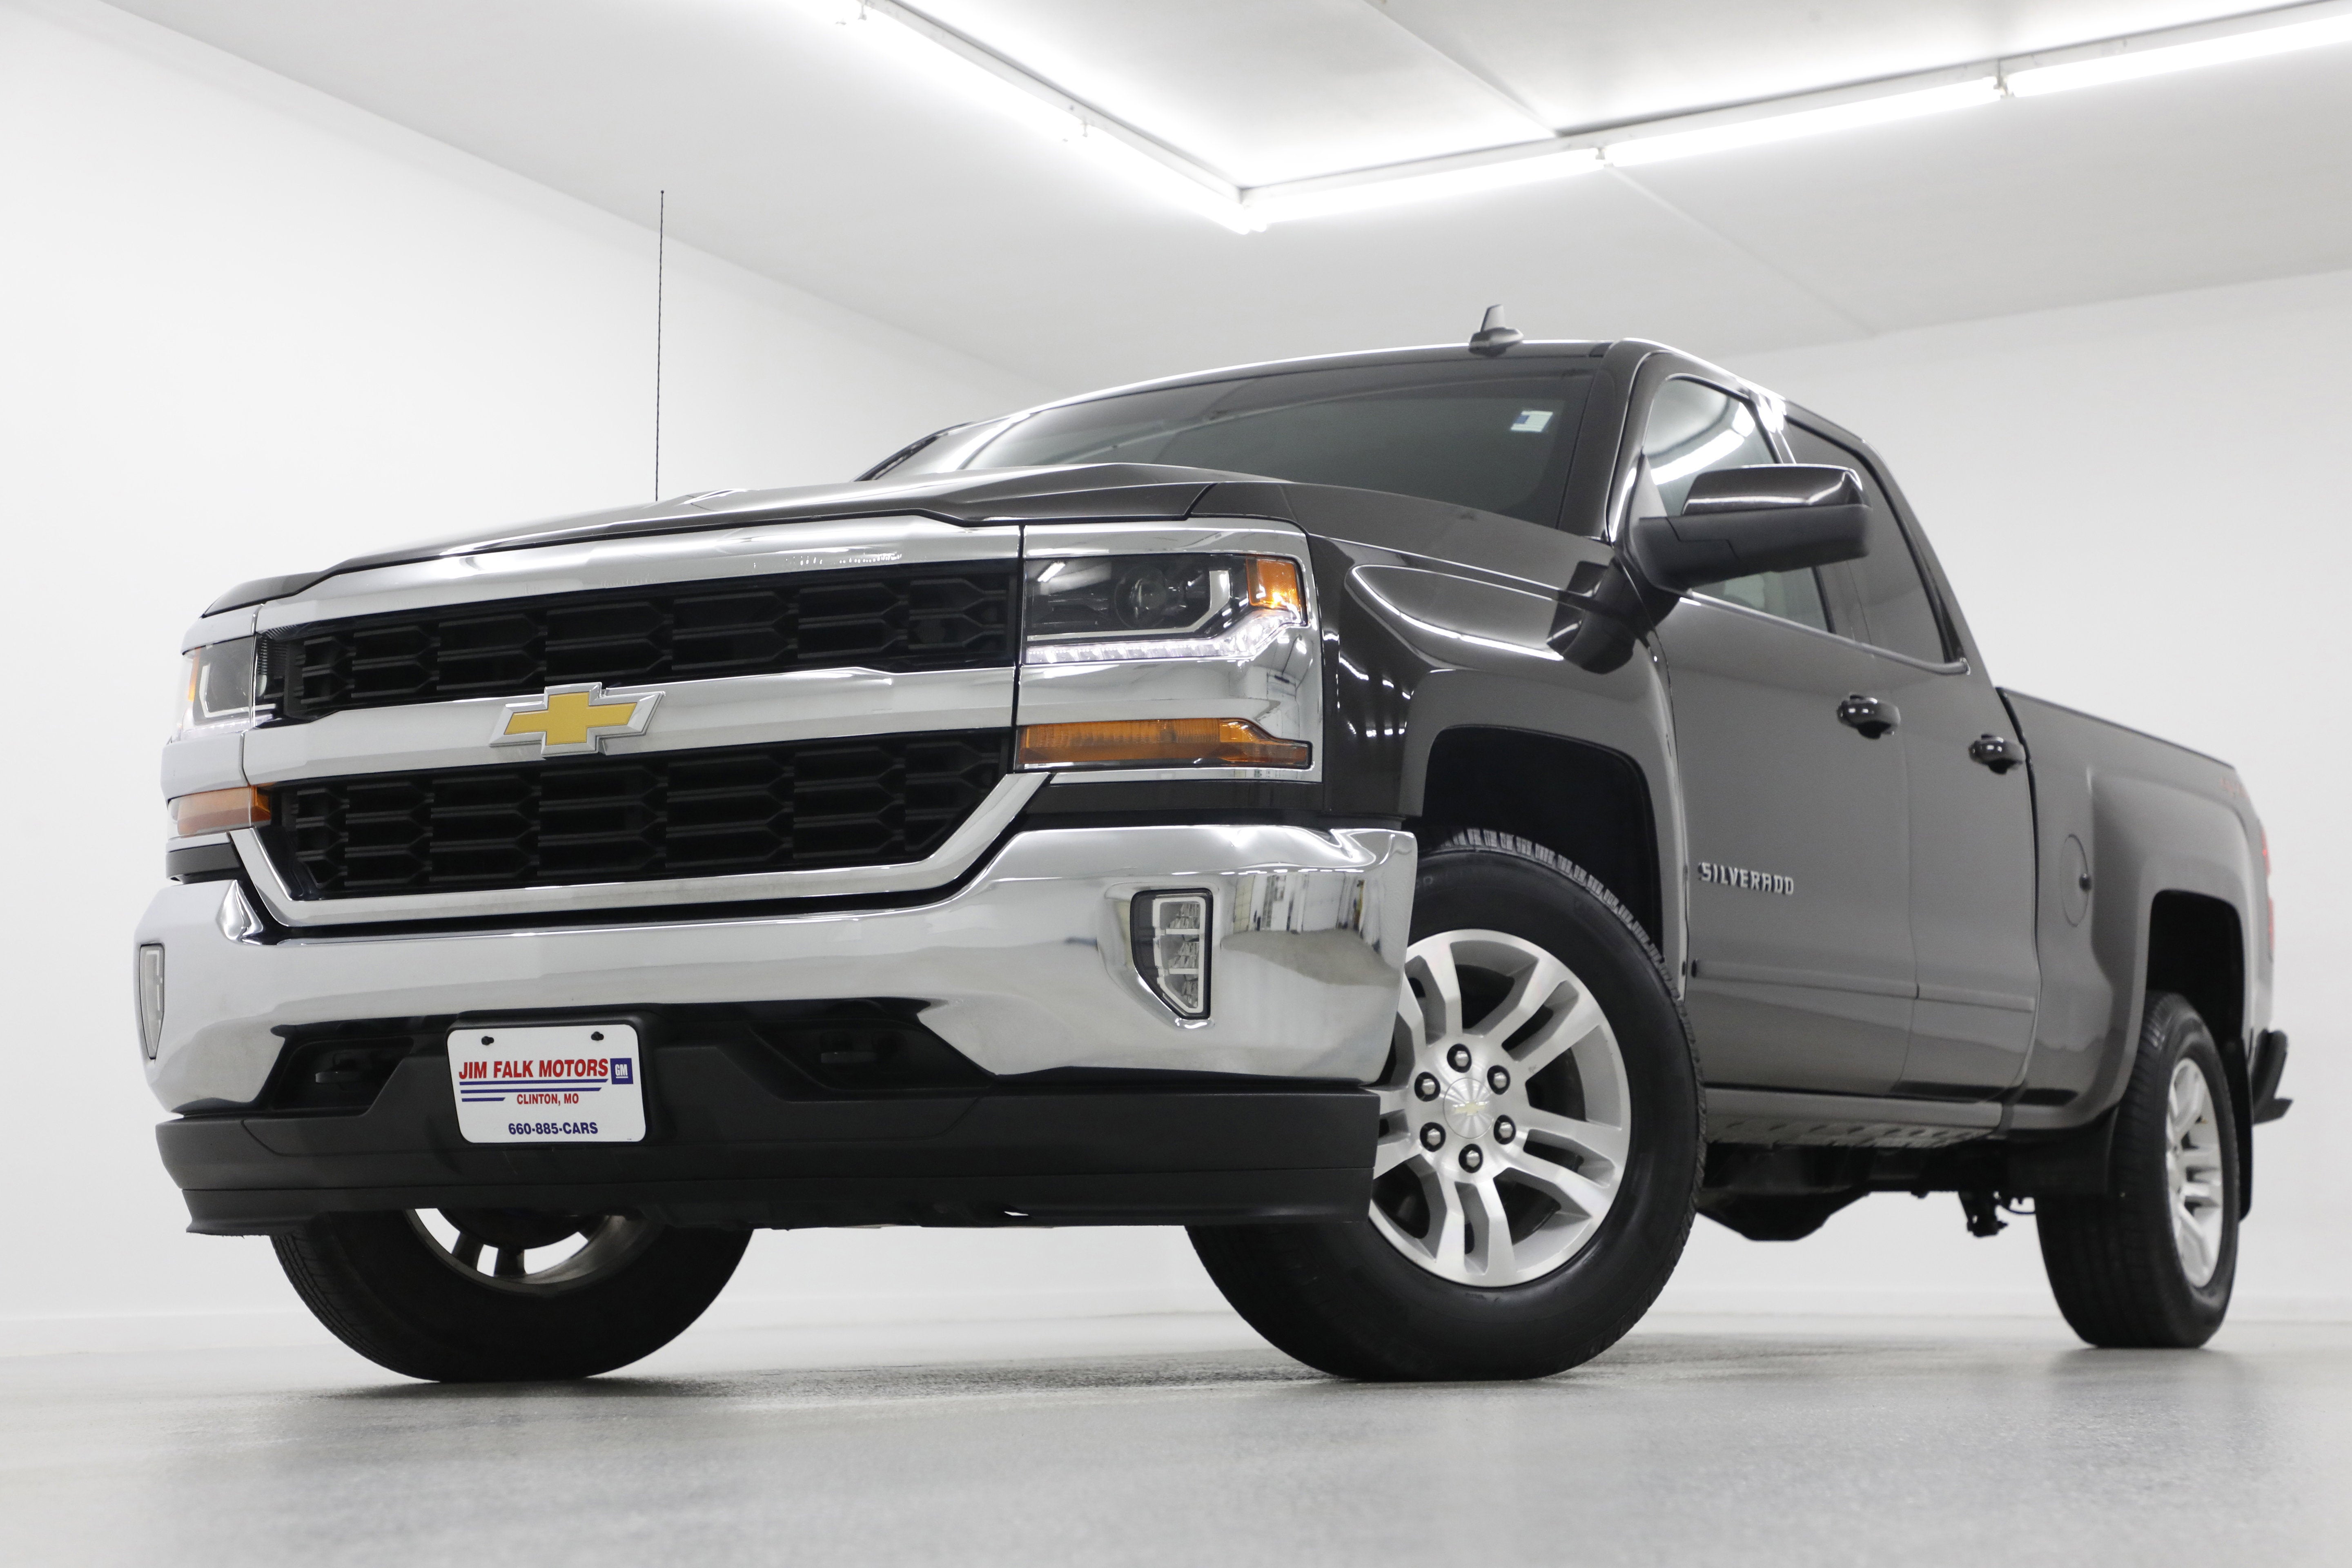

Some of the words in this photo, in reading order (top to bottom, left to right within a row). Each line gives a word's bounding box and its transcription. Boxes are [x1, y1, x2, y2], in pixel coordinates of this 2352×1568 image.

[1699, 862, 1794, 895] SILVERADO
[459, 1062, 487, 1079] JIM
[494, 1060, 533, 1078] FALK
[539, 1058, 608, 1077] MOTORS
[615, 1063, 628, 1076] GM
[517, 1093, 561, 1106] CLINTON,
[564, 1093, 579, 1104] MO
[508, 1122, 598, 1135] 660-885-CARS
